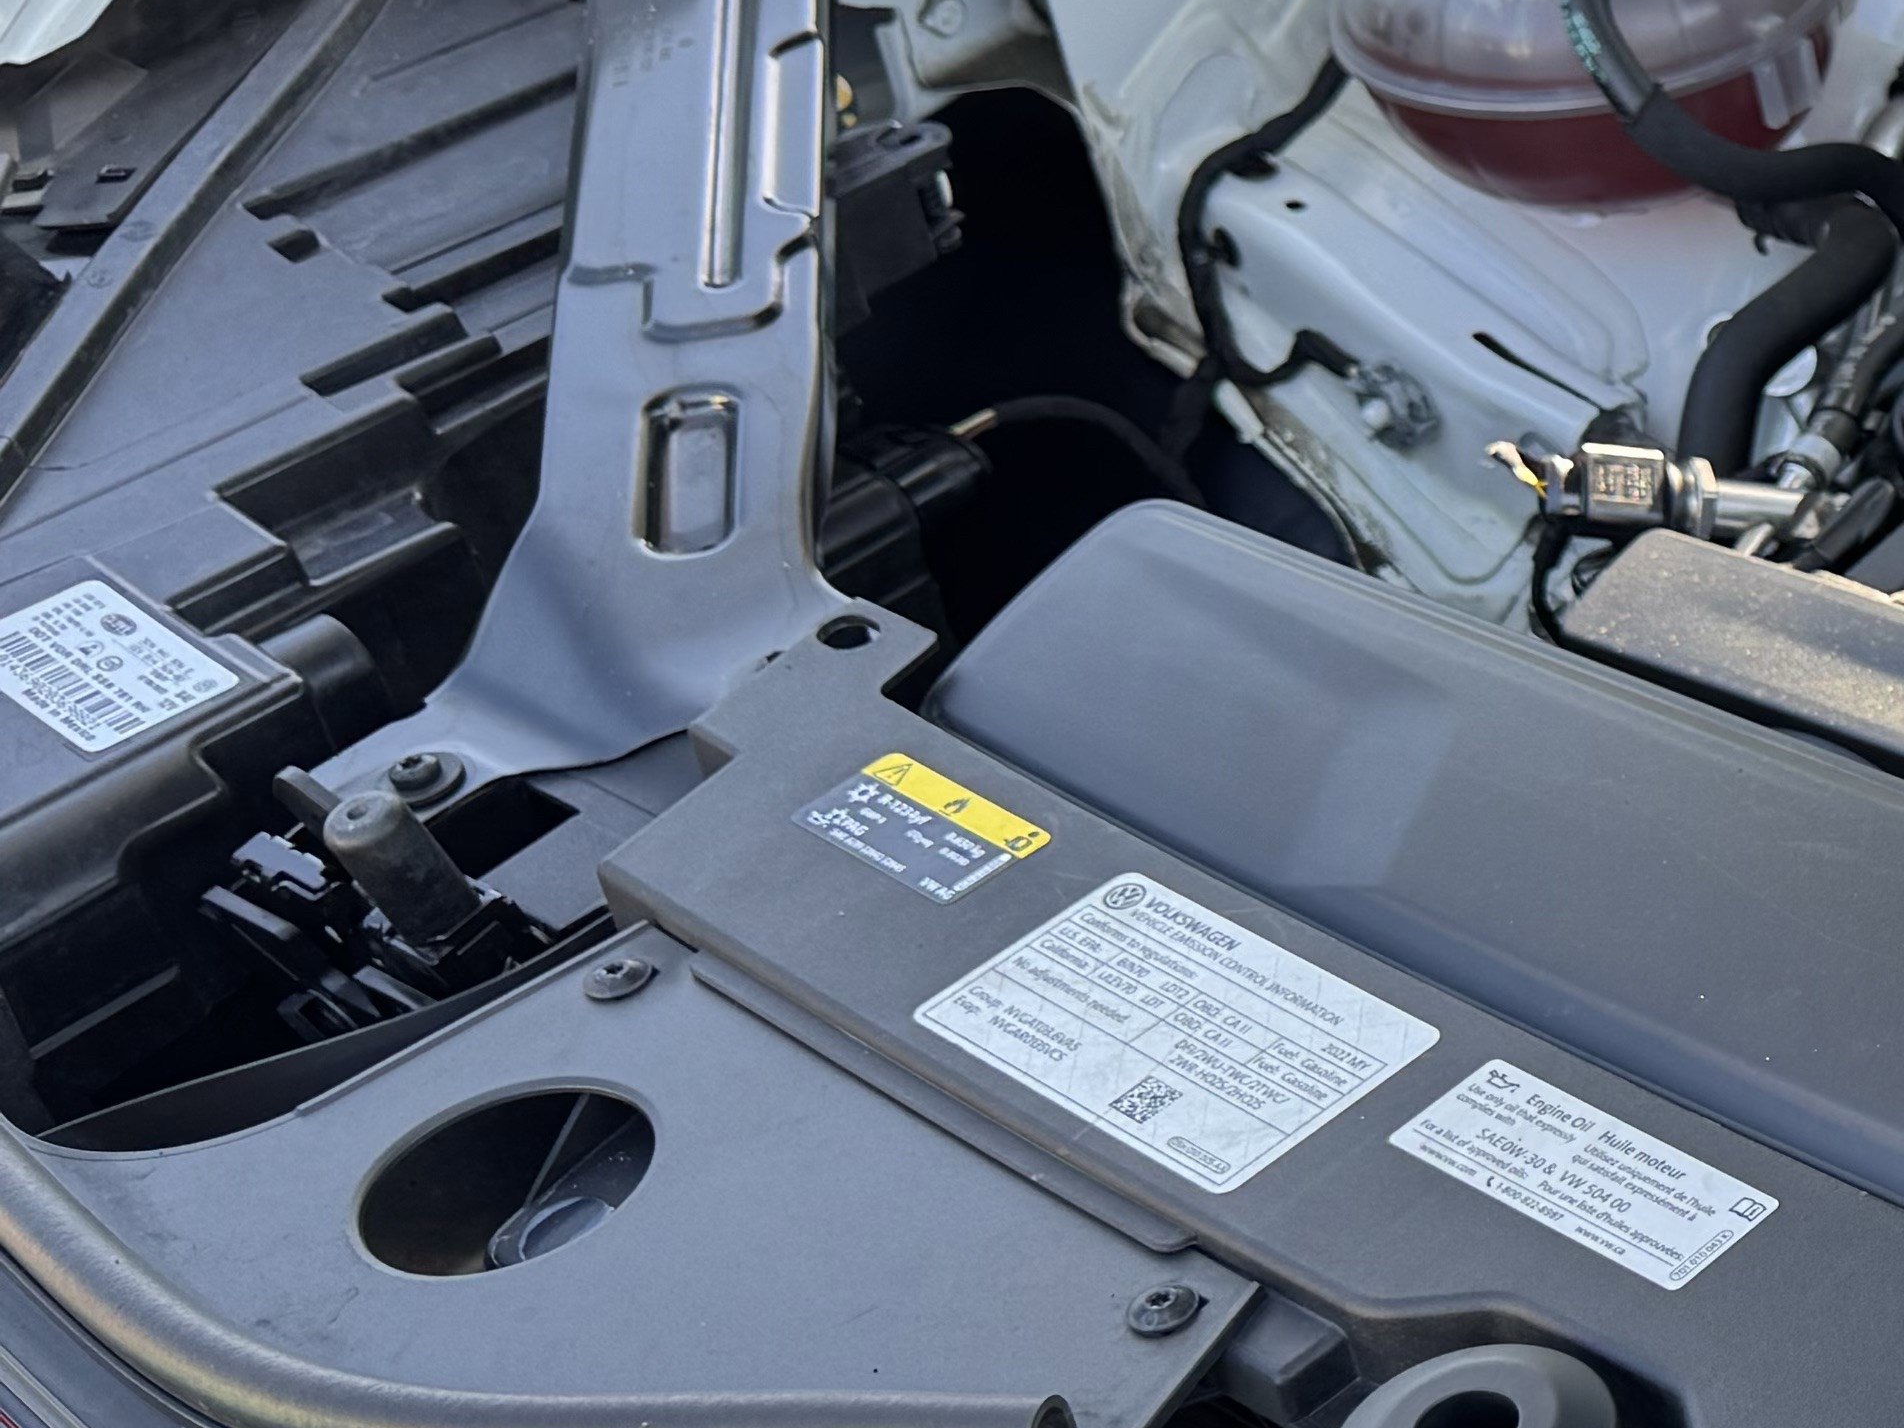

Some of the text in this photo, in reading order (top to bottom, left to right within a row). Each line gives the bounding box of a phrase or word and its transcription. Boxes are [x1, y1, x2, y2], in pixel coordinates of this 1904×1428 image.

[1078, 911, 1130, 943] Conforms
[1126, 937, 1142, 949] to
[1144, 896, 1242, 952] VOLKSWAGEN
[1129, 908, 1345, 1027] VEHICLE EMISSION CONTROL INFORMATION
[1299, 1057, 1348, 1088] Gasoline
[1320, 1042, 1372, 1071] 2022 MY
[1525, 1093, 1597, 1133] Engine Oil
[1542, 1162, 1558, 1176] &
[1583, 1143, 1620, 1167] Utilisez
[1617, 1163, 1677, 1196] uniquement
[1673, 1191, 1688, 1203] de
[1597, 1130, 1687, 1180] Huile moteur
[1559, 1169, 1632, 1214] VW 504 00
